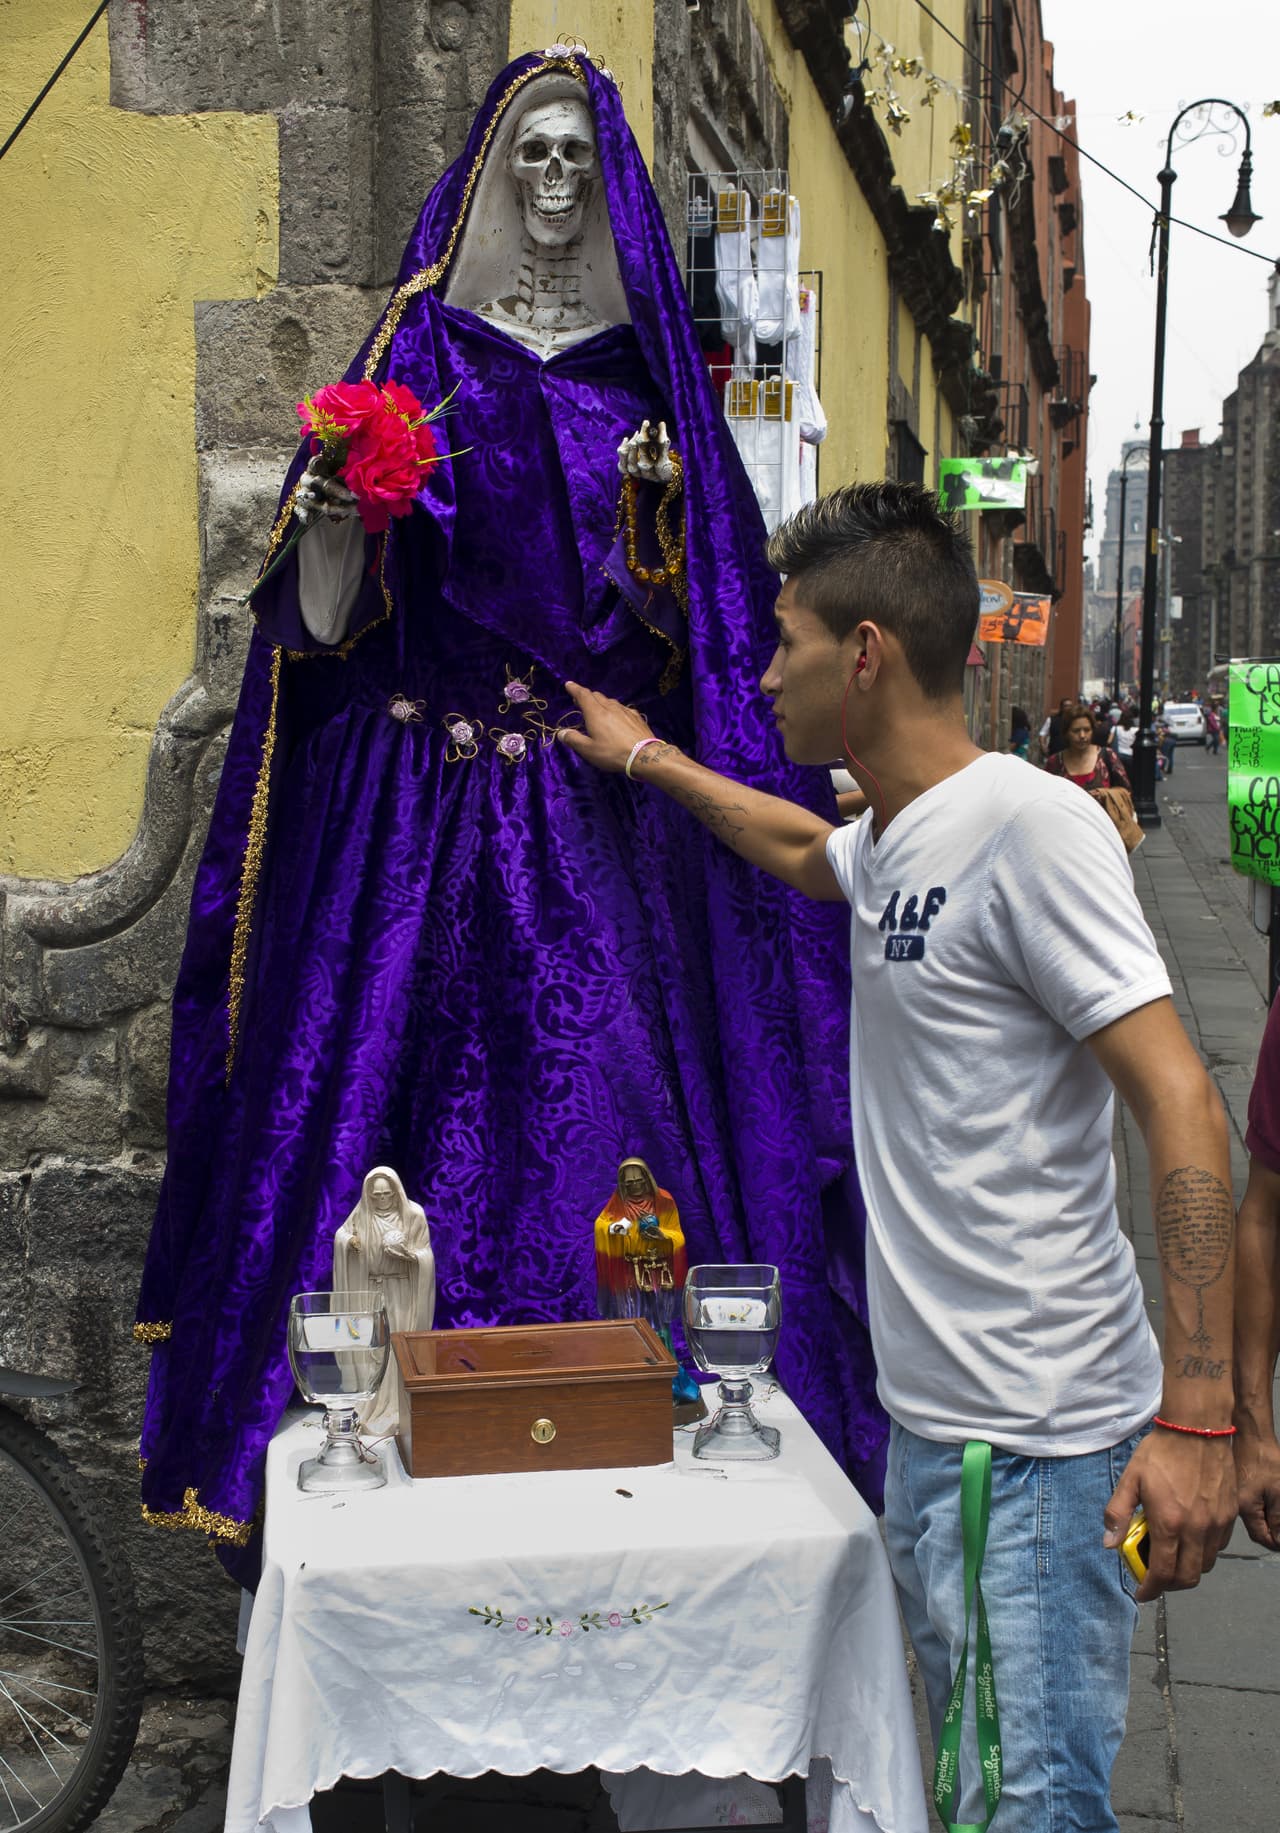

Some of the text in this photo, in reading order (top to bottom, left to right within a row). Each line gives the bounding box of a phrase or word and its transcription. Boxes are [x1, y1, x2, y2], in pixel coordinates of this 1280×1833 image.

[889, 938, 913, 958] NY
[983, 1663, 996, 1720] Schneider
[934, 1747, 950, 1804] Schneider
[988, 1744, 1001, 1800] Schneider
